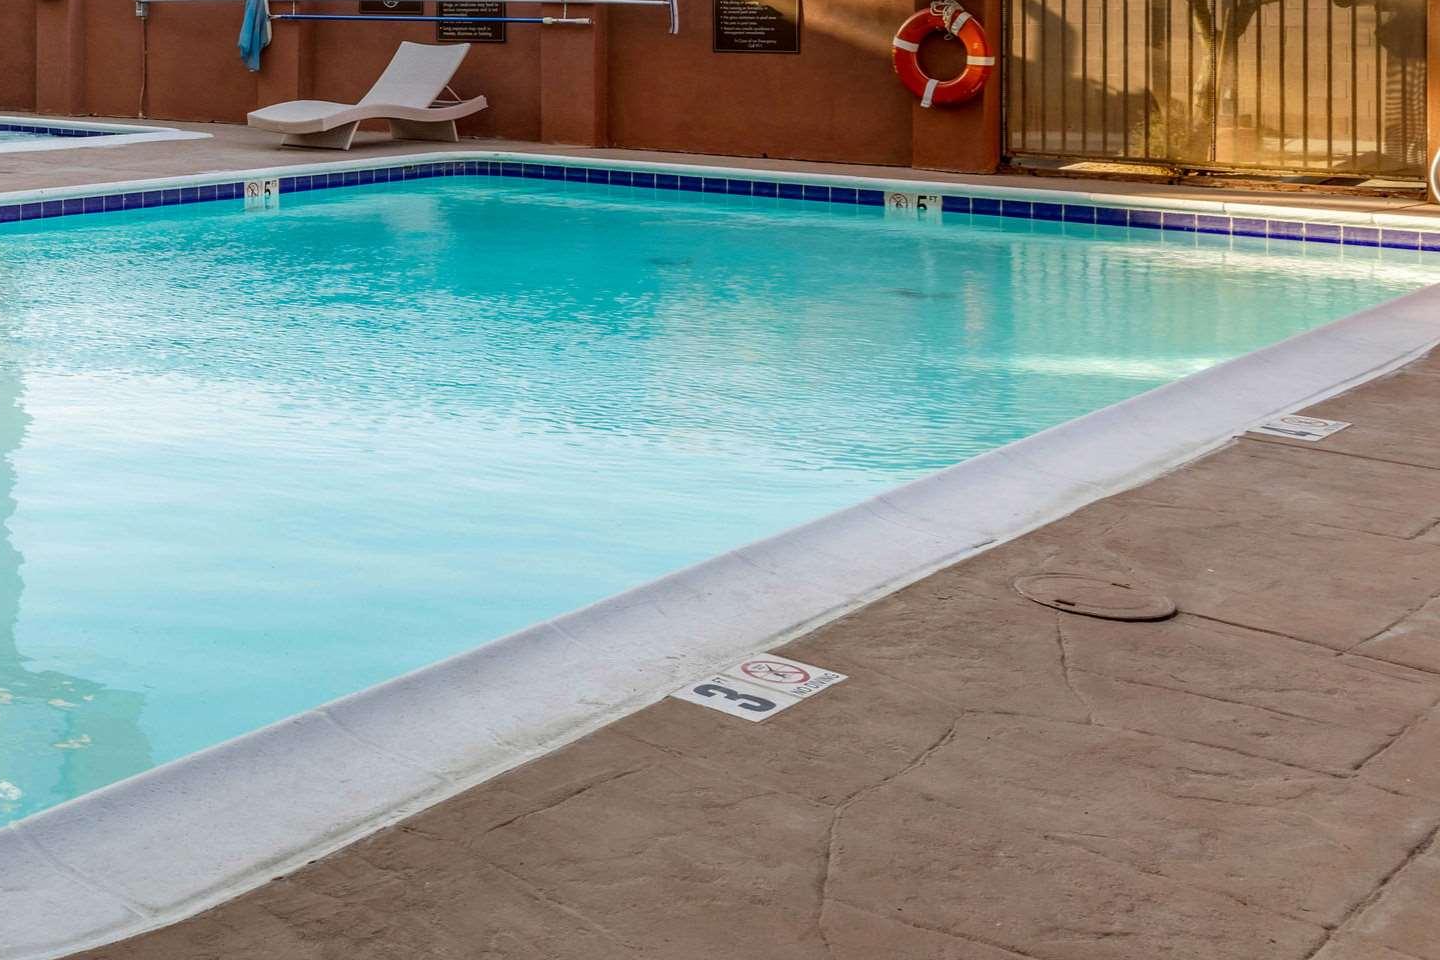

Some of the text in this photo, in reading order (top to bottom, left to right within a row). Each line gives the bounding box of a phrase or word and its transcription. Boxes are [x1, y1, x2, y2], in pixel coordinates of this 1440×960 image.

[693, 683, 777, 713] 3
[790, 671, 842, 697] NO DIVING
